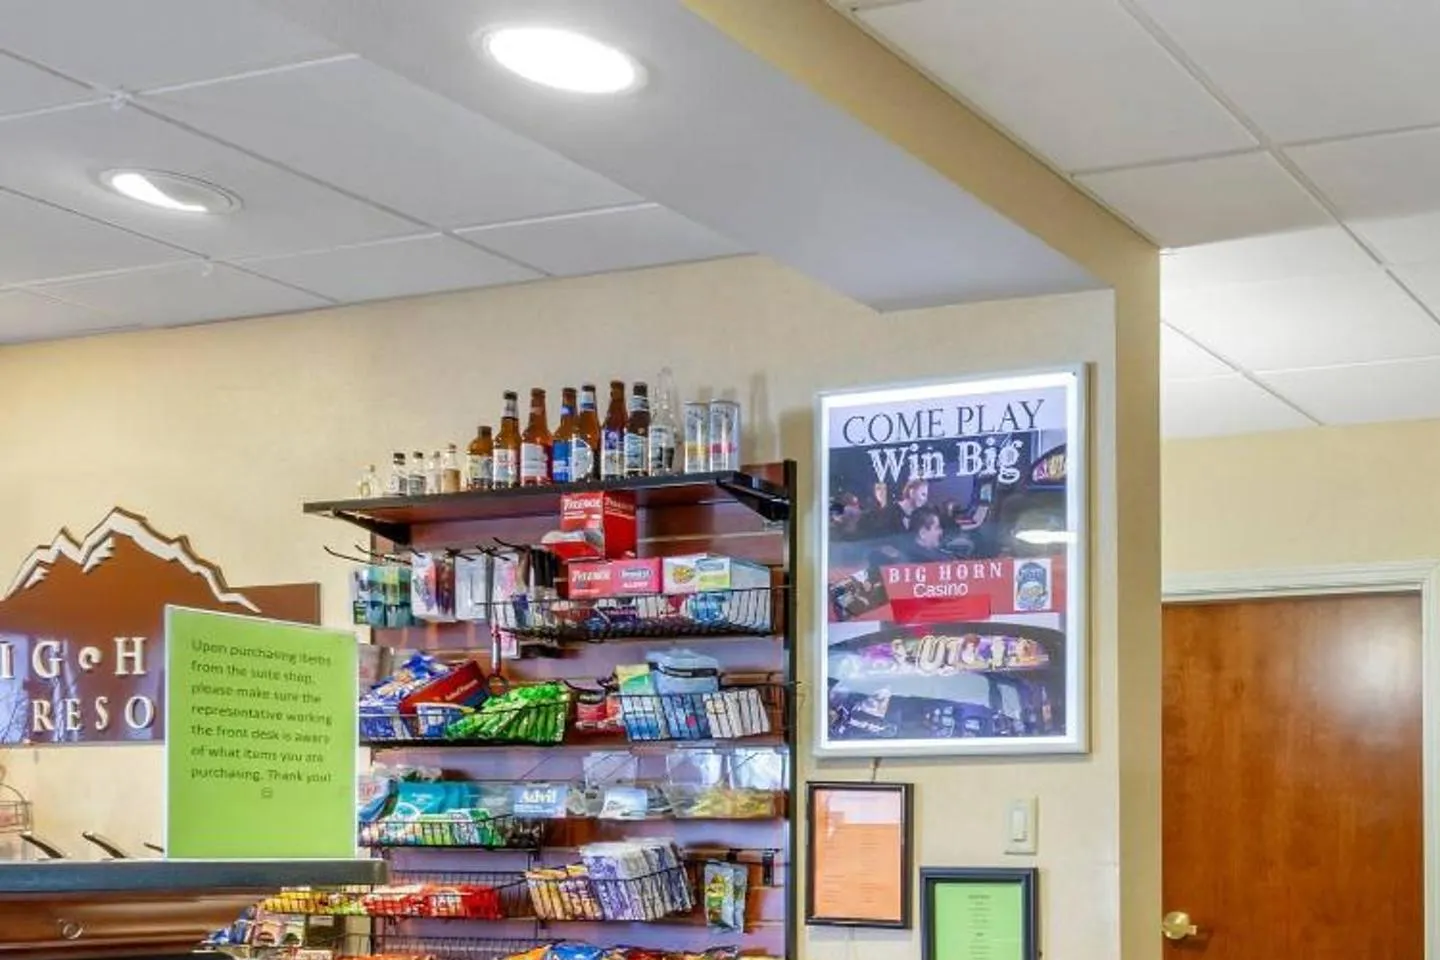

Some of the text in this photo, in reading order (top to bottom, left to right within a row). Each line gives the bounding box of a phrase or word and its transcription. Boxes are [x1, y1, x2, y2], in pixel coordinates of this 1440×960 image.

[843, 399, 1045, 445] COME PLAY
[868, 437, 1024, 484] Win Big
[889, 562, 1004, 585] BIG HORN
[913, 581, 969, 599] Casino
[0, 638, 62, 679] IG
[192, 639, 332, 666] Upon purchasing items
[191, 660, 223, 674] from
[227, 665, 247, 676] the
[191, 684, 321, 703] please make sure the
[32, 695, 155, 733] RESO
[191, 705, 332, 726] representative working
[191, 724, 213, 736] the
[216, 725, 249, 739] front
[251, 730, 279, 741] desk
[295, 734, 330, 745] aware
[191, 745, 323, 763] of what items you are
[267, 769, 303, 781] Thank
[520, 789, 557, 804] Advil
